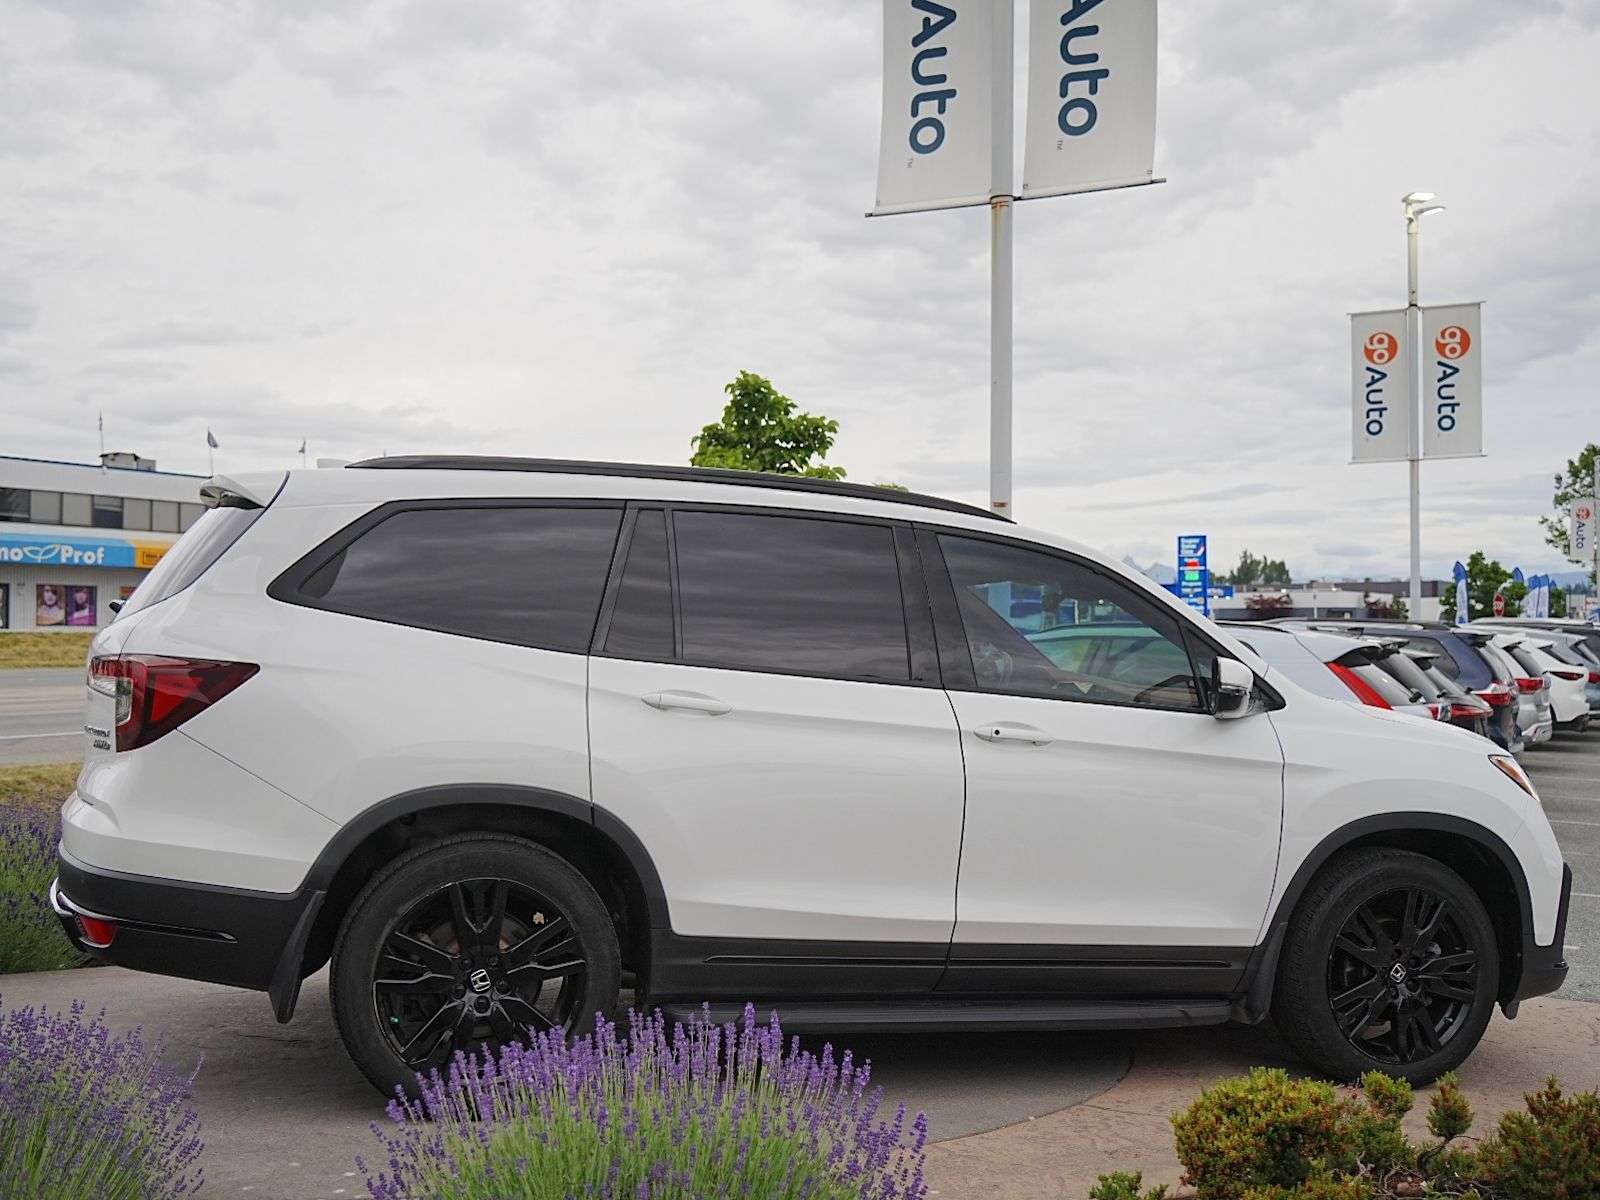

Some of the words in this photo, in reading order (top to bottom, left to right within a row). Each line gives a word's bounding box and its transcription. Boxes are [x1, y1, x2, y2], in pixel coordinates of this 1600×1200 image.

[909, 0, 957, 155] Auto
[1366, 366, 1388, 436] Auto
[1437, 361, 1460, 431] Auto
[61, 545, 105, 564] Prof
